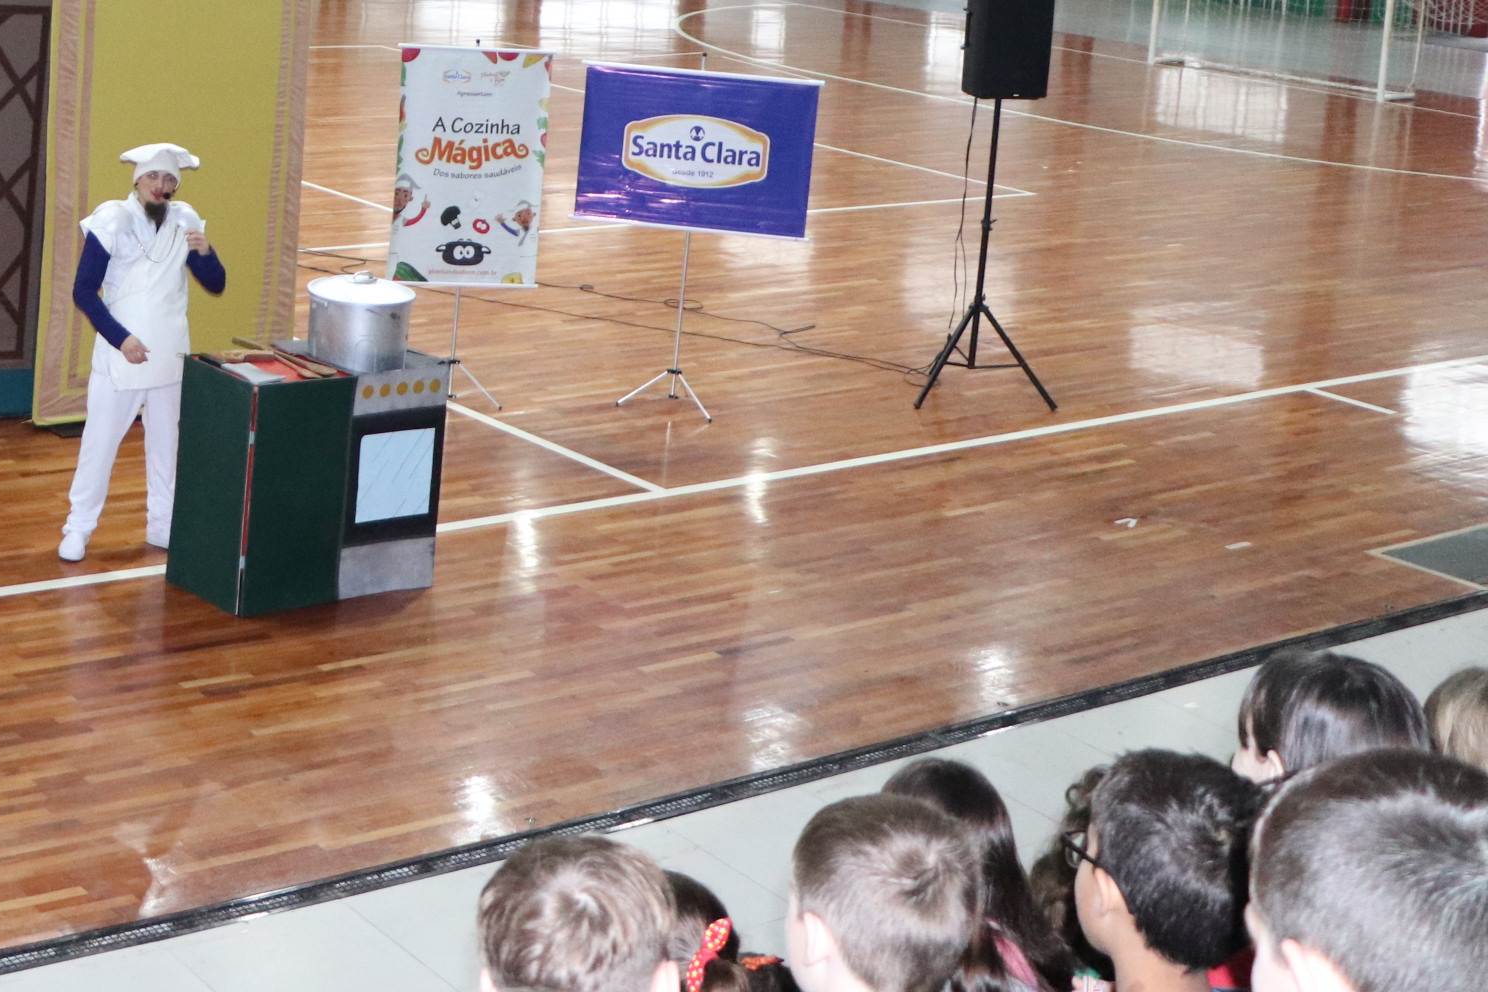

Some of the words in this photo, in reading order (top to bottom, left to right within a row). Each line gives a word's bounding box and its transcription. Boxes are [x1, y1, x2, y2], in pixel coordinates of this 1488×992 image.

[432, 116, 447, 132] A
[451, 117, 521, 135] Cozinha
[415, 136, 529, 170] Mágica
[631, 134, 696, 162] Santa
[700, 141, 761, 168] Clara
[433, 168, 449, 178] Dos
[450, 169, 483, 180] sabores
[484, 164, 522, 179] saudáveis
[697, 170, 714, 178] 1912
